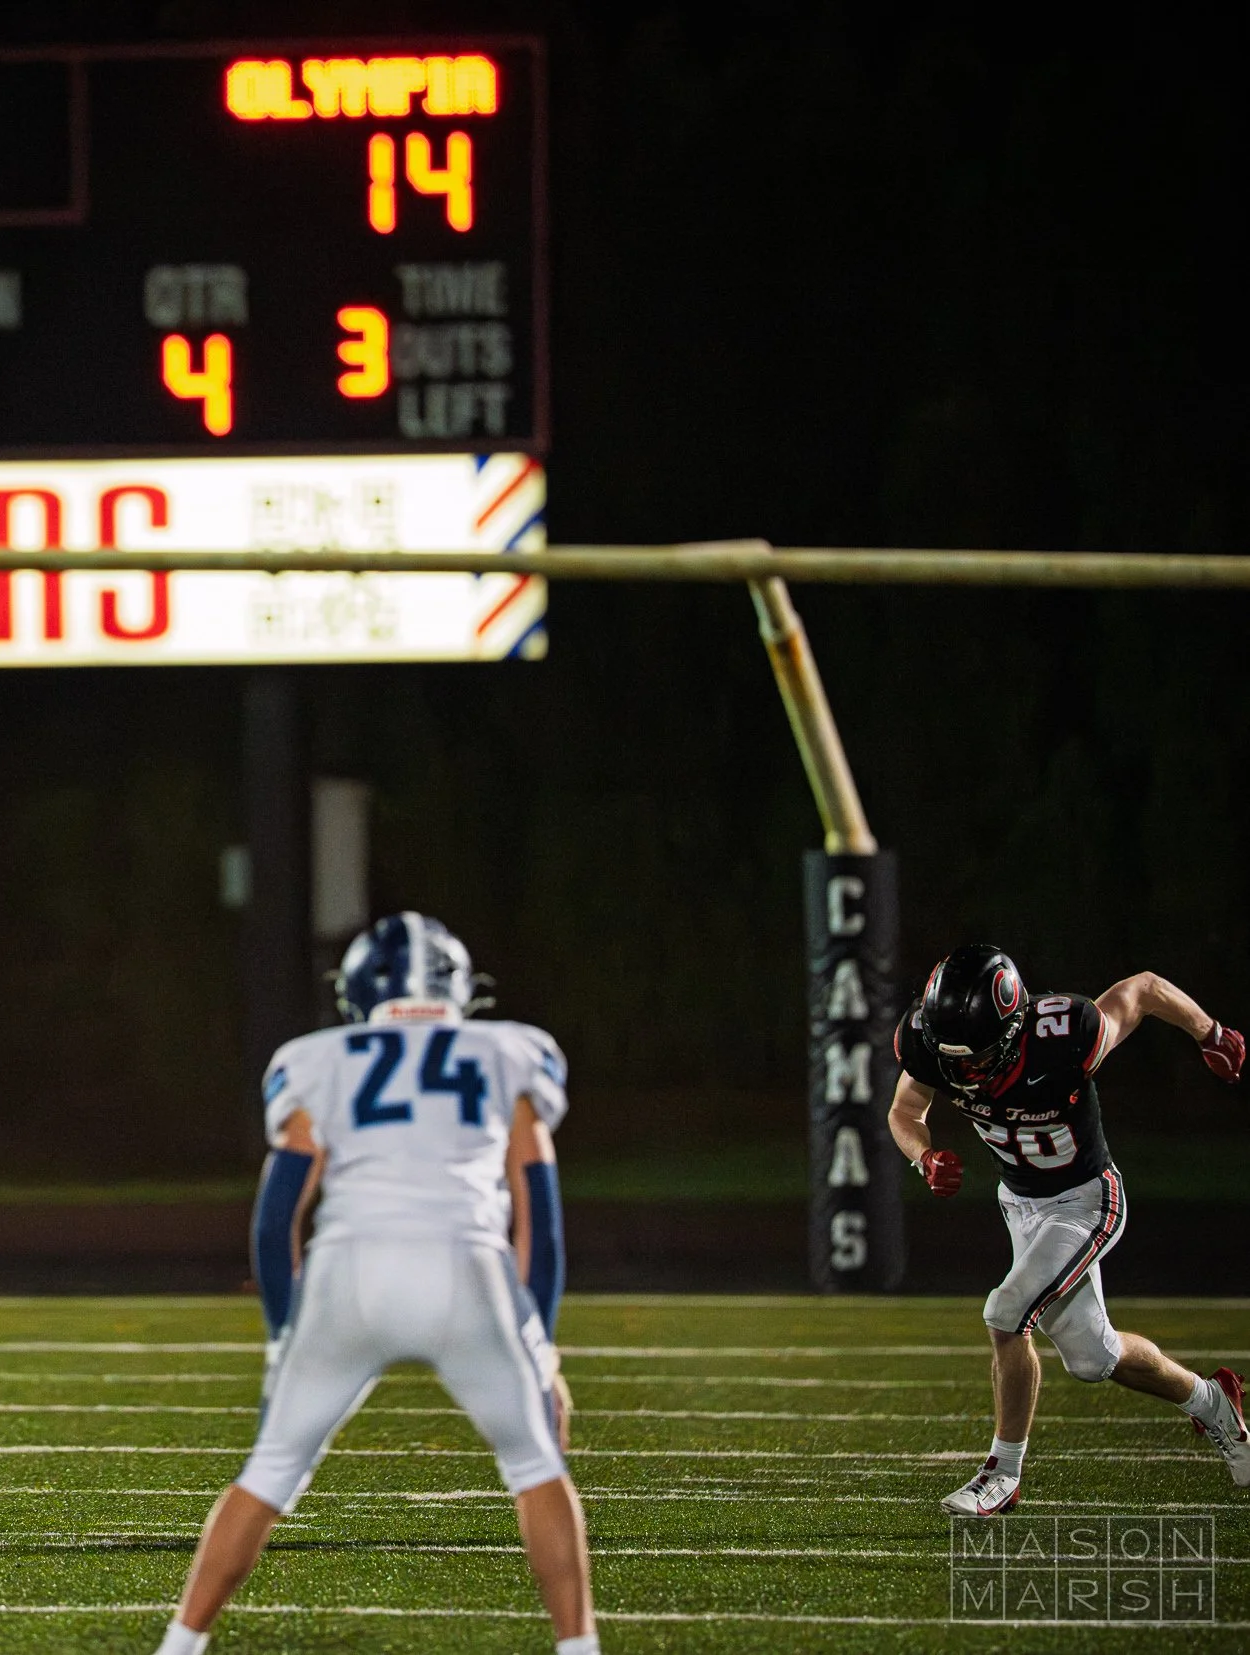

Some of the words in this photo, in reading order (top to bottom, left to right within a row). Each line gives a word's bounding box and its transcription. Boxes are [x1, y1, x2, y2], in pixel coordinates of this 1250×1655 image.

[226, 55, 498, 119] OLYMPIA
[368, 131, 473, 234] 14
[144, 263, 248, 328] QTR
[396, 262, 507, 317] TIME
[162, 333, 232, 437] 4
[337, 306, 389, 398] 3
[398, 383, 508, 438] LEFT
[1035, 996, 1073, 1039] 20
[345, 1028, 488, 1129] 24
[825, 875, 873, 1273] CAMAS
